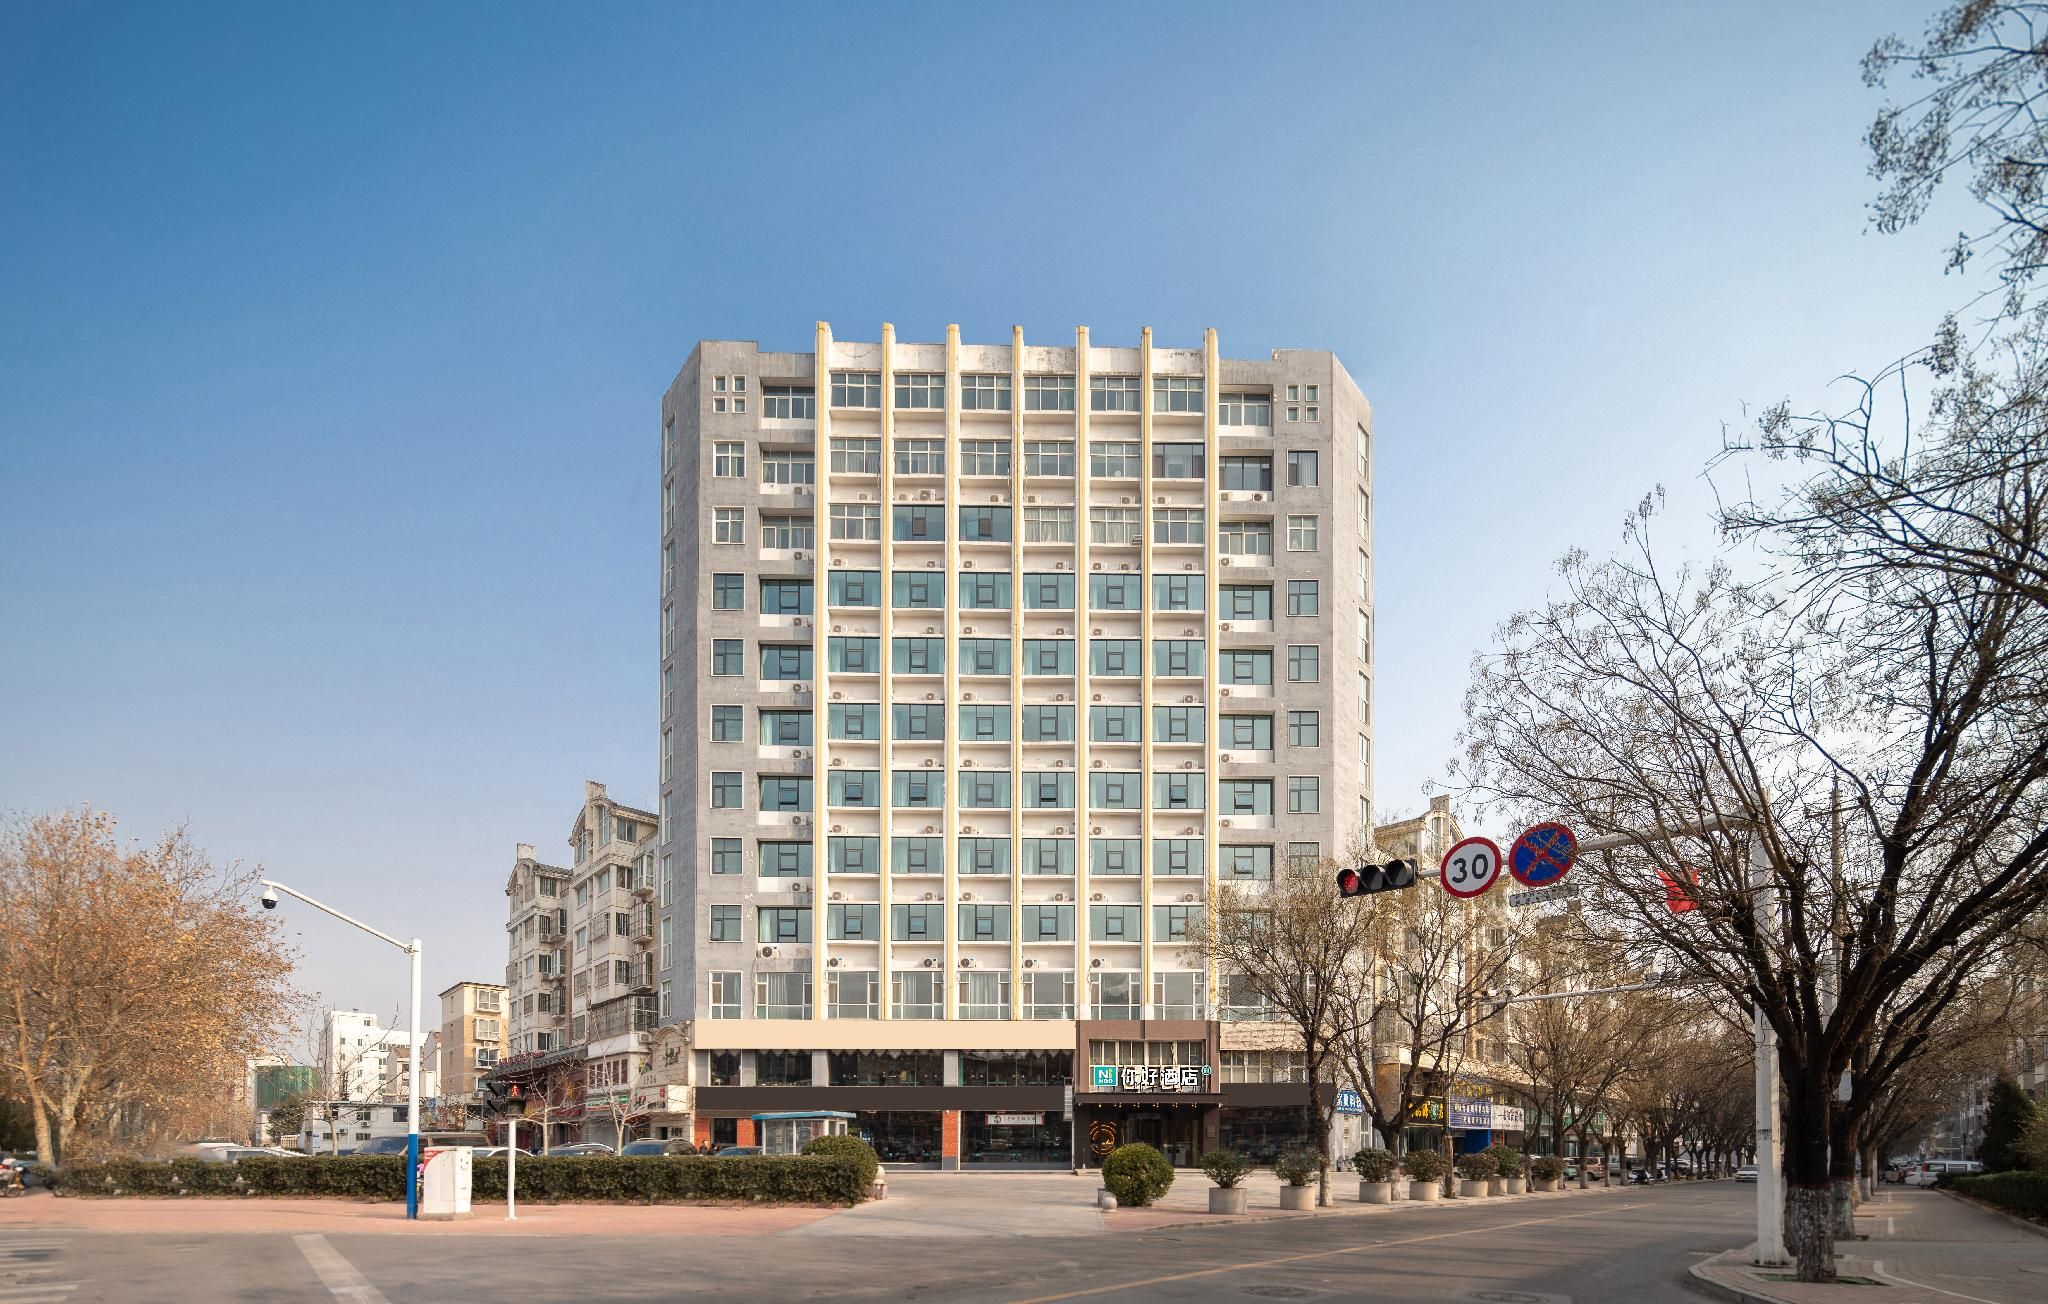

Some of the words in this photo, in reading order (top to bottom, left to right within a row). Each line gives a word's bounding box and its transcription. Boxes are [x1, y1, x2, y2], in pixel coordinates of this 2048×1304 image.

[1452, 854, 1488, 883] 30
[1121, 1068, 1199, 1086] 你好酒店
